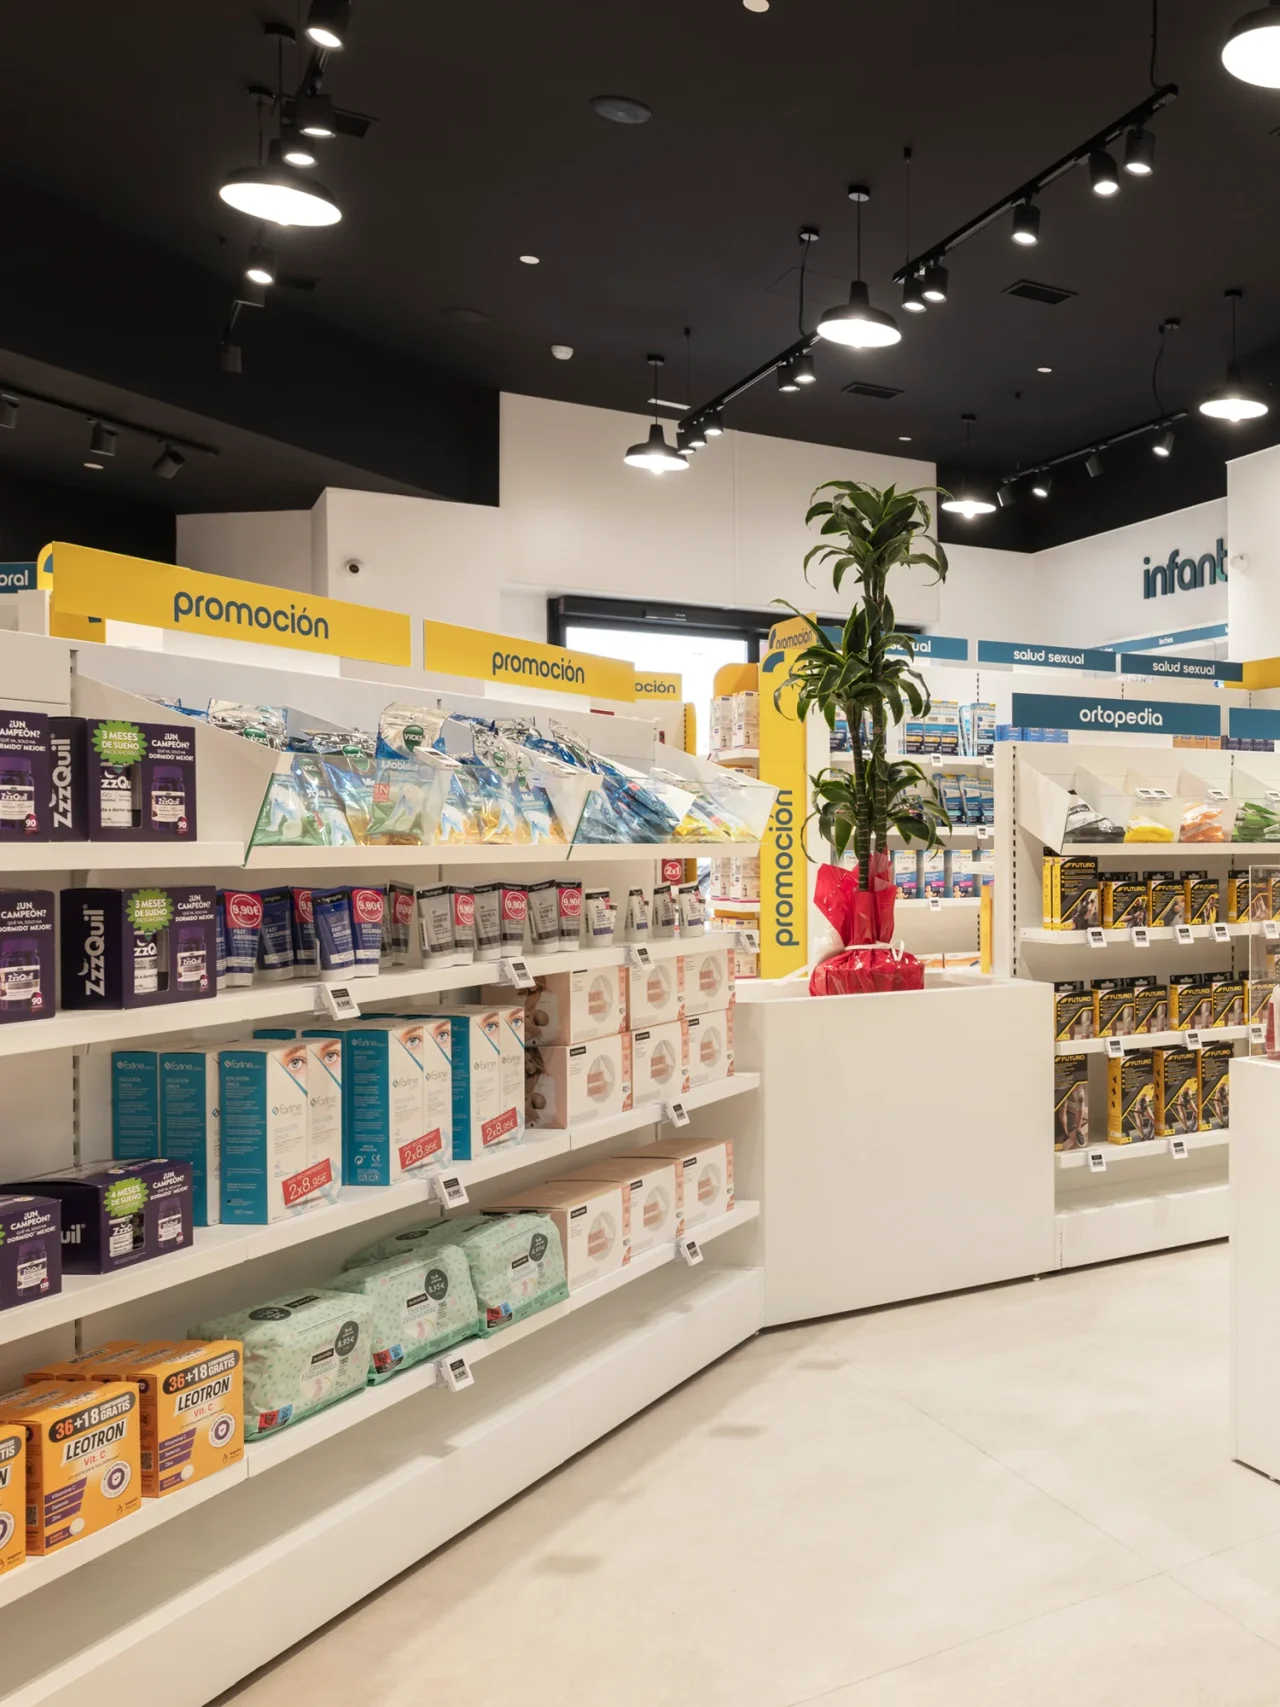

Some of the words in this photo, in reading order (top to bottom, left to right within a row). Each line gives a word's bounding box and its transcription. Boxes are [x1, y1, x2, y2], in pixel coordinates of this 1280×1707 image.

[1143, 537, 1229, 600] infant
[173, 591, 330, 640] promoción
[1158, 634, 1175, 647] leches
[1013, 648, 1046, 664] salud
[1048, 651, 1085, 666] sexual
[492, 650, 586, 684] promoción
[1152, 660, 1180, 674] salud
[1183, 662, 1216, 676] sexual
[635, 680, 677, 695] oción
[9, 719, 26, 729] ¿UN
[1079, 706, 1164, 729] ortopedia
[0, 726, 41, 739] AMPEÓN?
[109, 731, 138, 742] MESES
[101, 740, 110, 749] DE
[111, 740, 140, 750] SUEÑO
[151, 739, 190, 750] CAMPEÓN?
[26, 819, 36, 828] 90
[665, 866, 680, 876] 2x1
[768, 789, 800, 947] promoción
[16, 901, 33, 911] ¿UN
[140, 899, 167, 908] MESES
[177, 901, 211, 910] CAMPEÓN?
[232, 904, 260, 916] 9,90€
[358, 901, 383, 911] 9,90€
[506, 899, 527, 910] 9,90€
[1, 908, 47, 919] CAMPEÓN?
[134, 909, 144, 917] DE
[145, 908, 168, 917] SUEÑO
[31, 996, 42, 1005] 90
[152, 1174, 185, 1189] CAMPEÓN?
[288, 1172, 328, 1201] 2x8,95€
[117, 1184, 141, 1197] MESES
[10, 1214, 51, 1231] CAMPEÓN?
[208, 1357, 235, 1377] GRATIS
[168, 1363, 208, 1393] 36+18
[177, 1376, 231, 1413] LEOTRON
[100, 1400, 131, 1421] GRATIS
[55, 1406, 100, 1440] 36+18
[65, 1420, 126, 1462] LEOTRON
